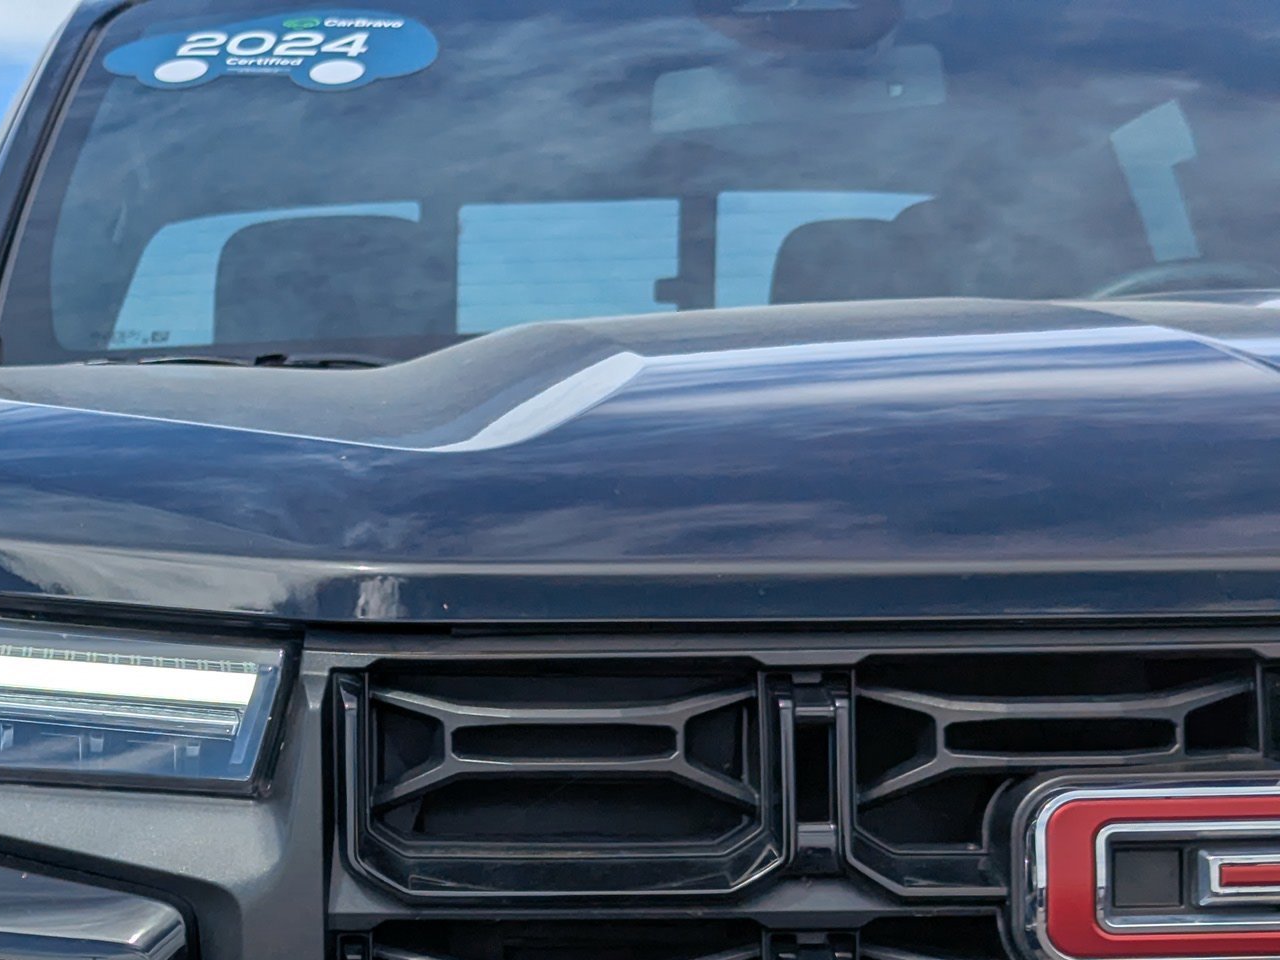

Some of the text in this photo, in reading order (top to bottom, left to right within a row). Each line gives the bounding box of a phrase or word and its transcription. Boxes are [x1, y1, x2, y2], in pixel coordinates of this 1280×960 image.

[323, 18, 404, 29] CarBravo
[176, 31, 370, 57] 2024
[226, 57, 304, 67] Certified
